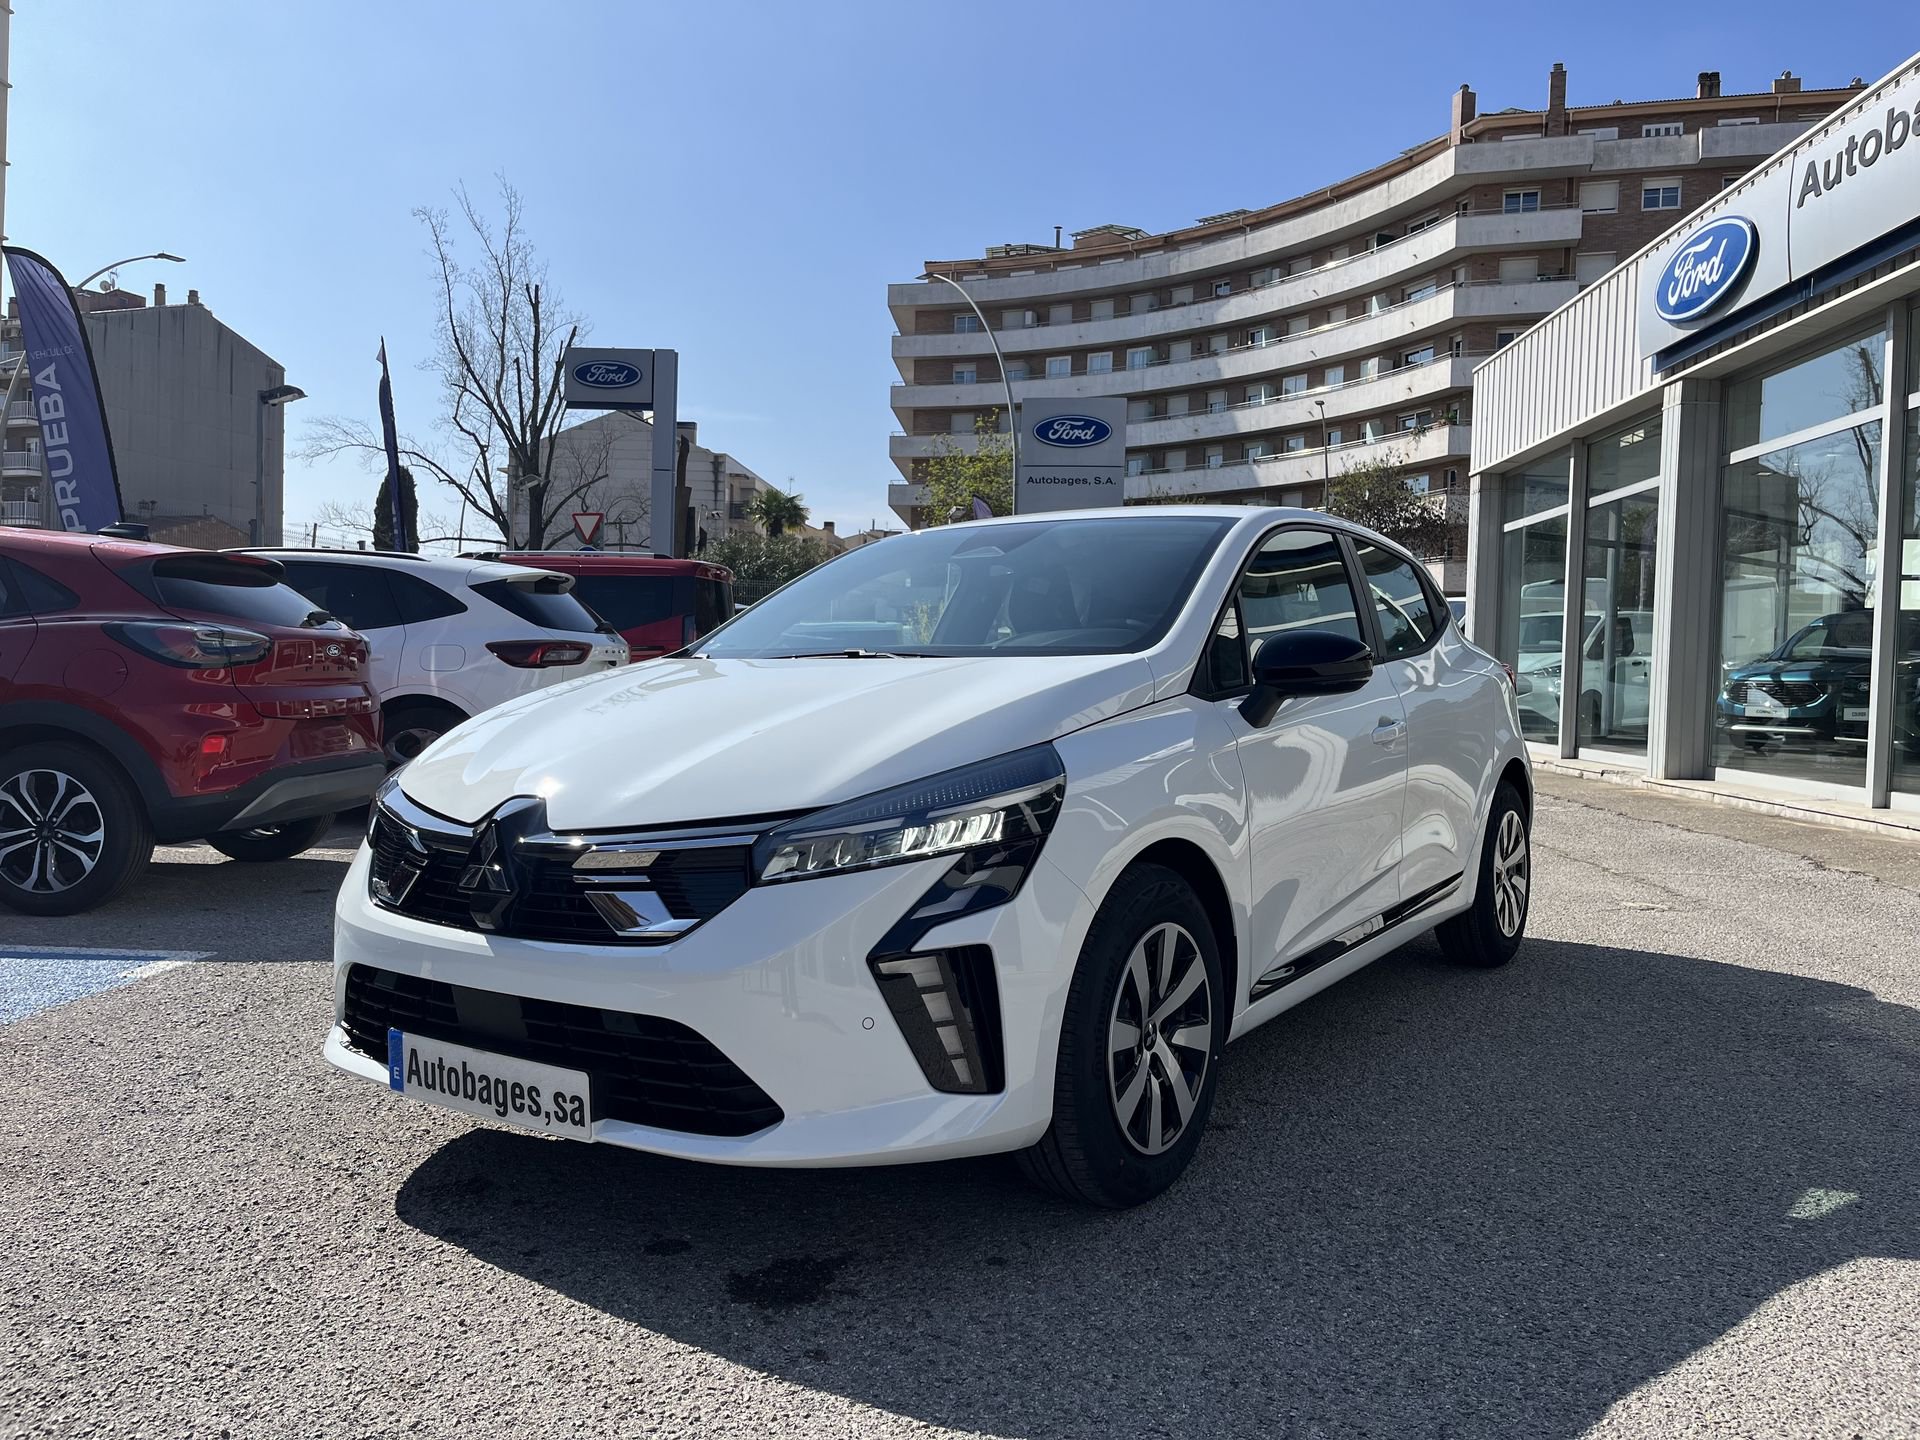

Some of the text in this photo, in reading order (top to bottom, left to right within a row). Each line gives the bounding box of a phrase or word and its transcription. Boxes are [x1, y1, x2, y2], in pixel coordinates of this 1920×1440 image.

[1668, 236, 1727, 306] Ford
[587, 364, 628, 383] Ford
[1048, 420, 1096, 440] Ford
[35, 362, 87, 533] PRUEBA
[1026, 476, 1117, 487] Autobages, S.A.
[393, 1066, 401, 1080] E
[406, 1047, 586, 1128] Autobages,sa
